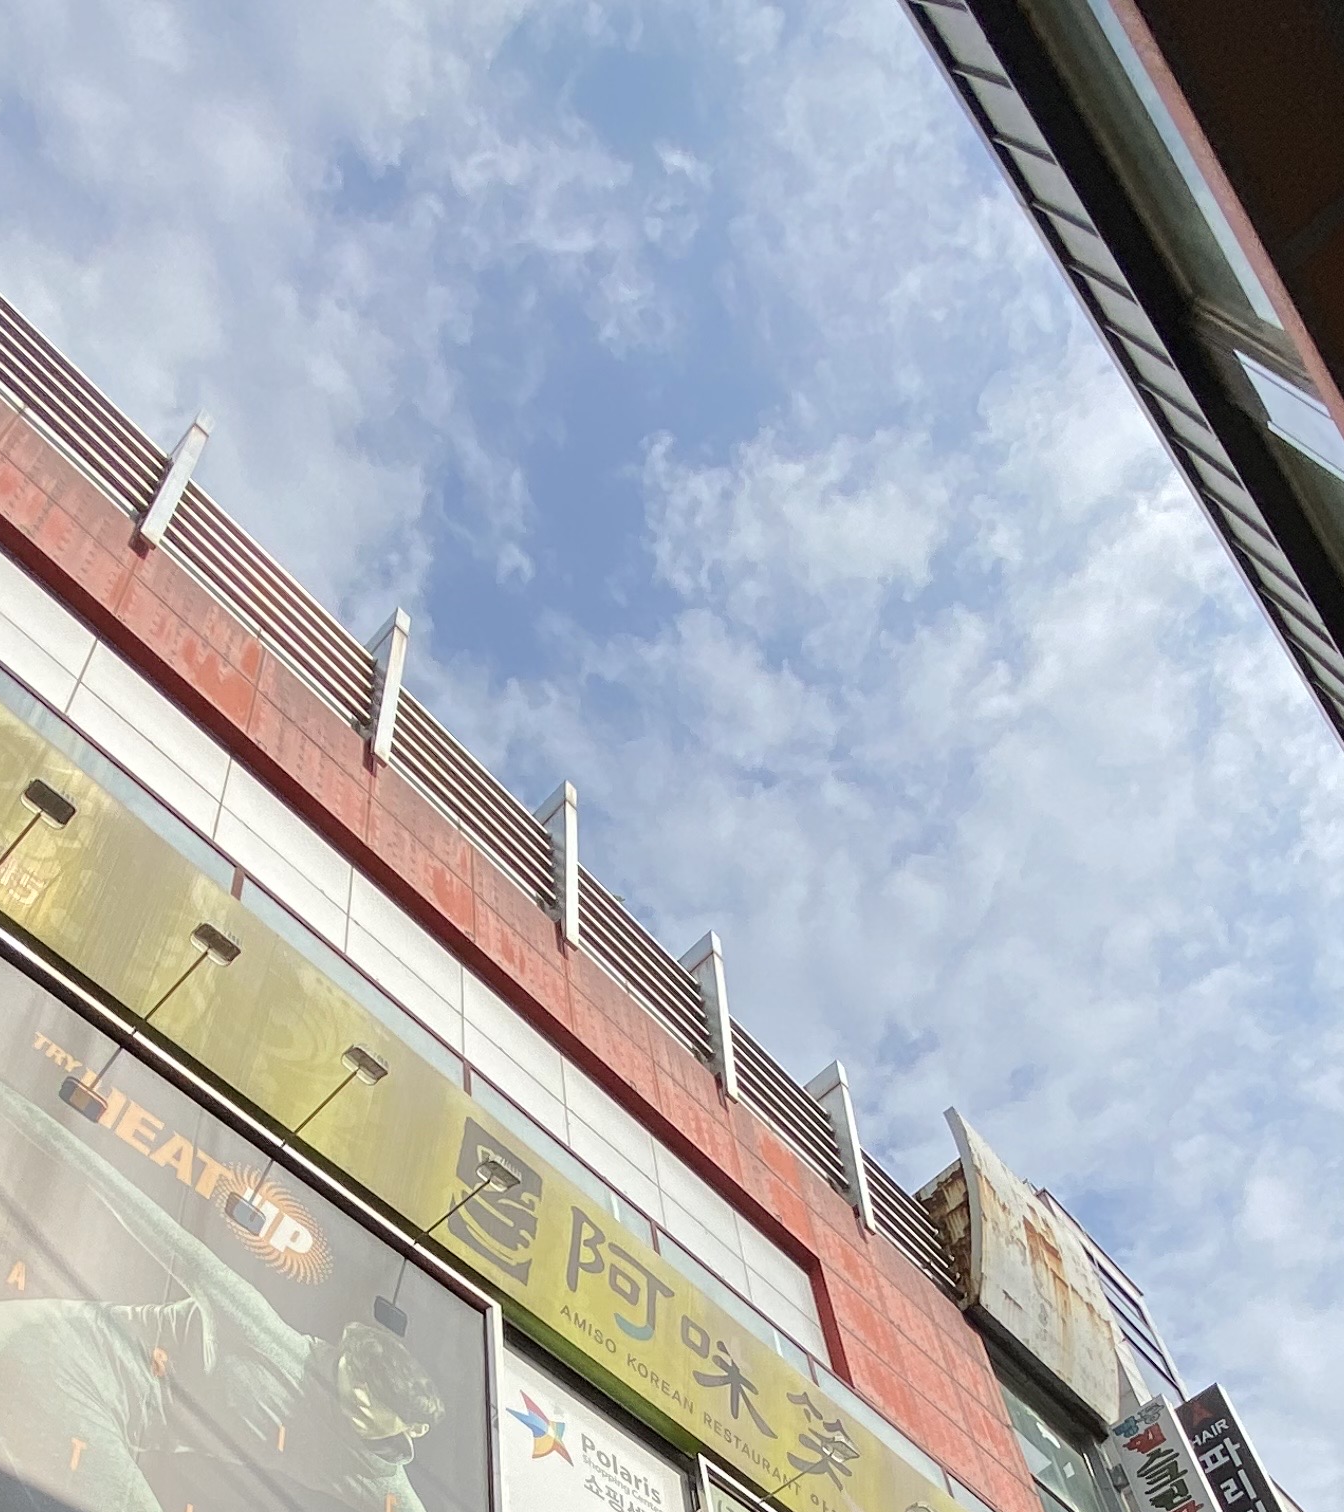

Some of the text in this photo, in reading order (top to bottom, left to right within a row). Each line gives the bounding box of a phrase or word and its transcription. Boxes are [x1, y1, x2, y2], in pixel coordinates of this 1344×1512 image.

[32, 1031, 83, 1074] TRY
[84, 1068, 234, 1202] HEAT
[559, 1304, 617, 1354] AMISO
[625, 1351, 695, 1416] KOREAN
[703, 1410, 802, 1497] RESTAURANT
[1191, 1417, 1230, 1446] HAIR
[579, 1432, 663, 1505] Polaris
[582, 1453, 634, 1498] Shopping
